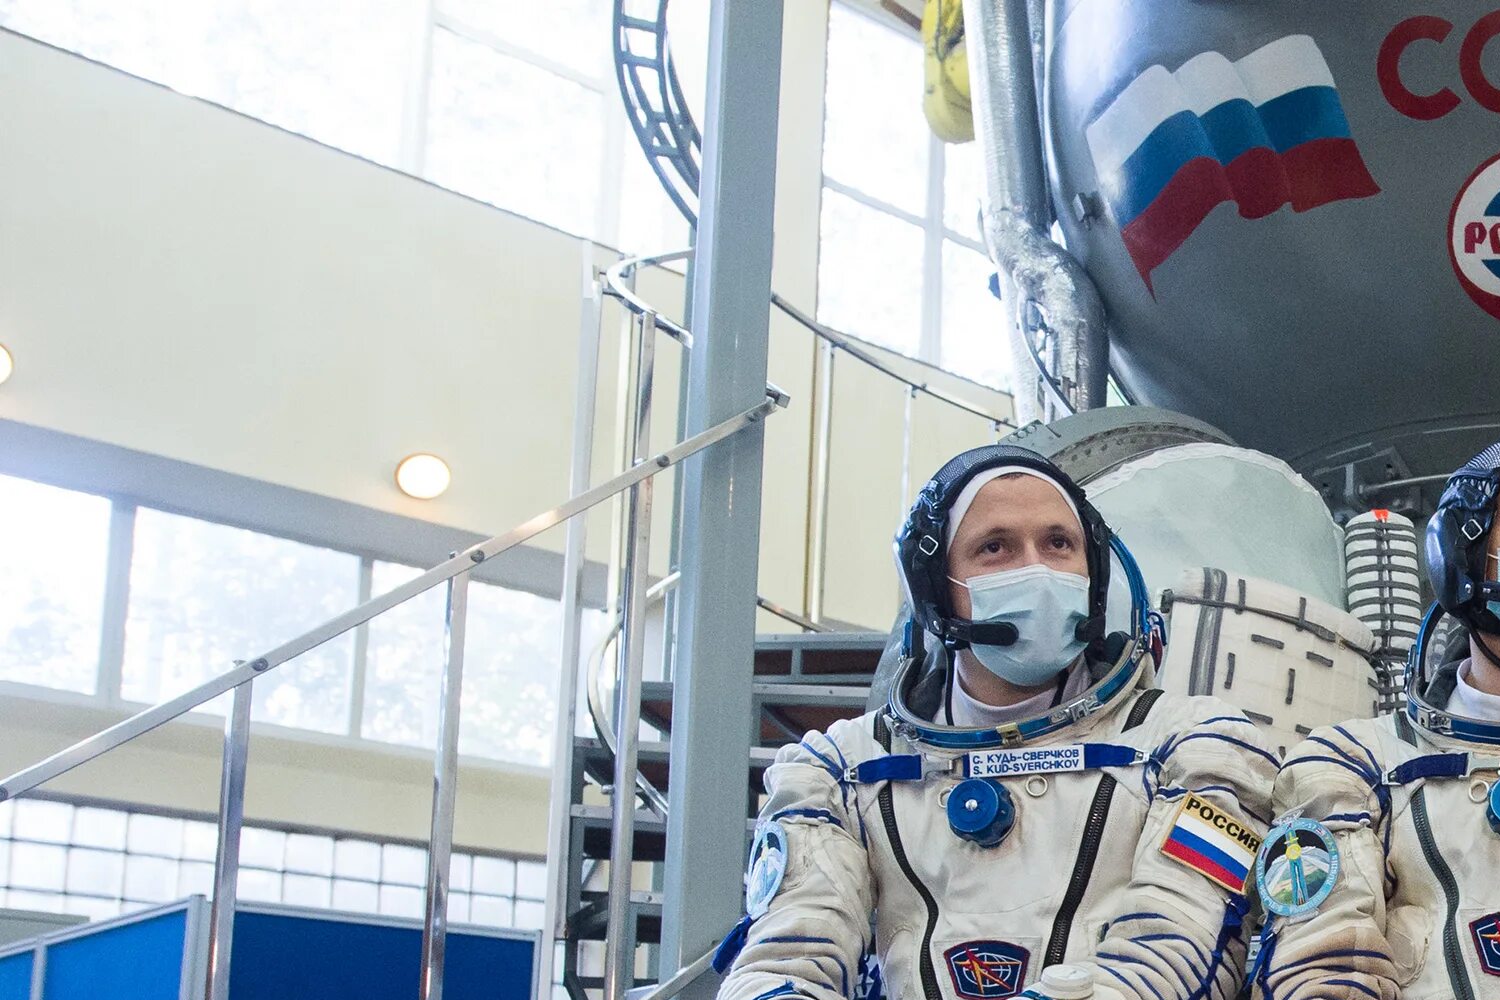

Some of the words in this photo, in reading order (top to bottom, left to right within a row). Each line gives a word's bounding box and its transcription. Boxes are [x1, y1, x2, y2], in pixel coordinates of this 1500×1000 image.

[972, 755, 984, 765] С.
[986, 749, 1080, 764] КУДЬ-СВЕРЧКОВ
[973, 765, 983, 775] S.
[986, 759, 1080, 774] KUD-SVERCHKOV
[1185, 797, 1261, 853] РОССИЯ
